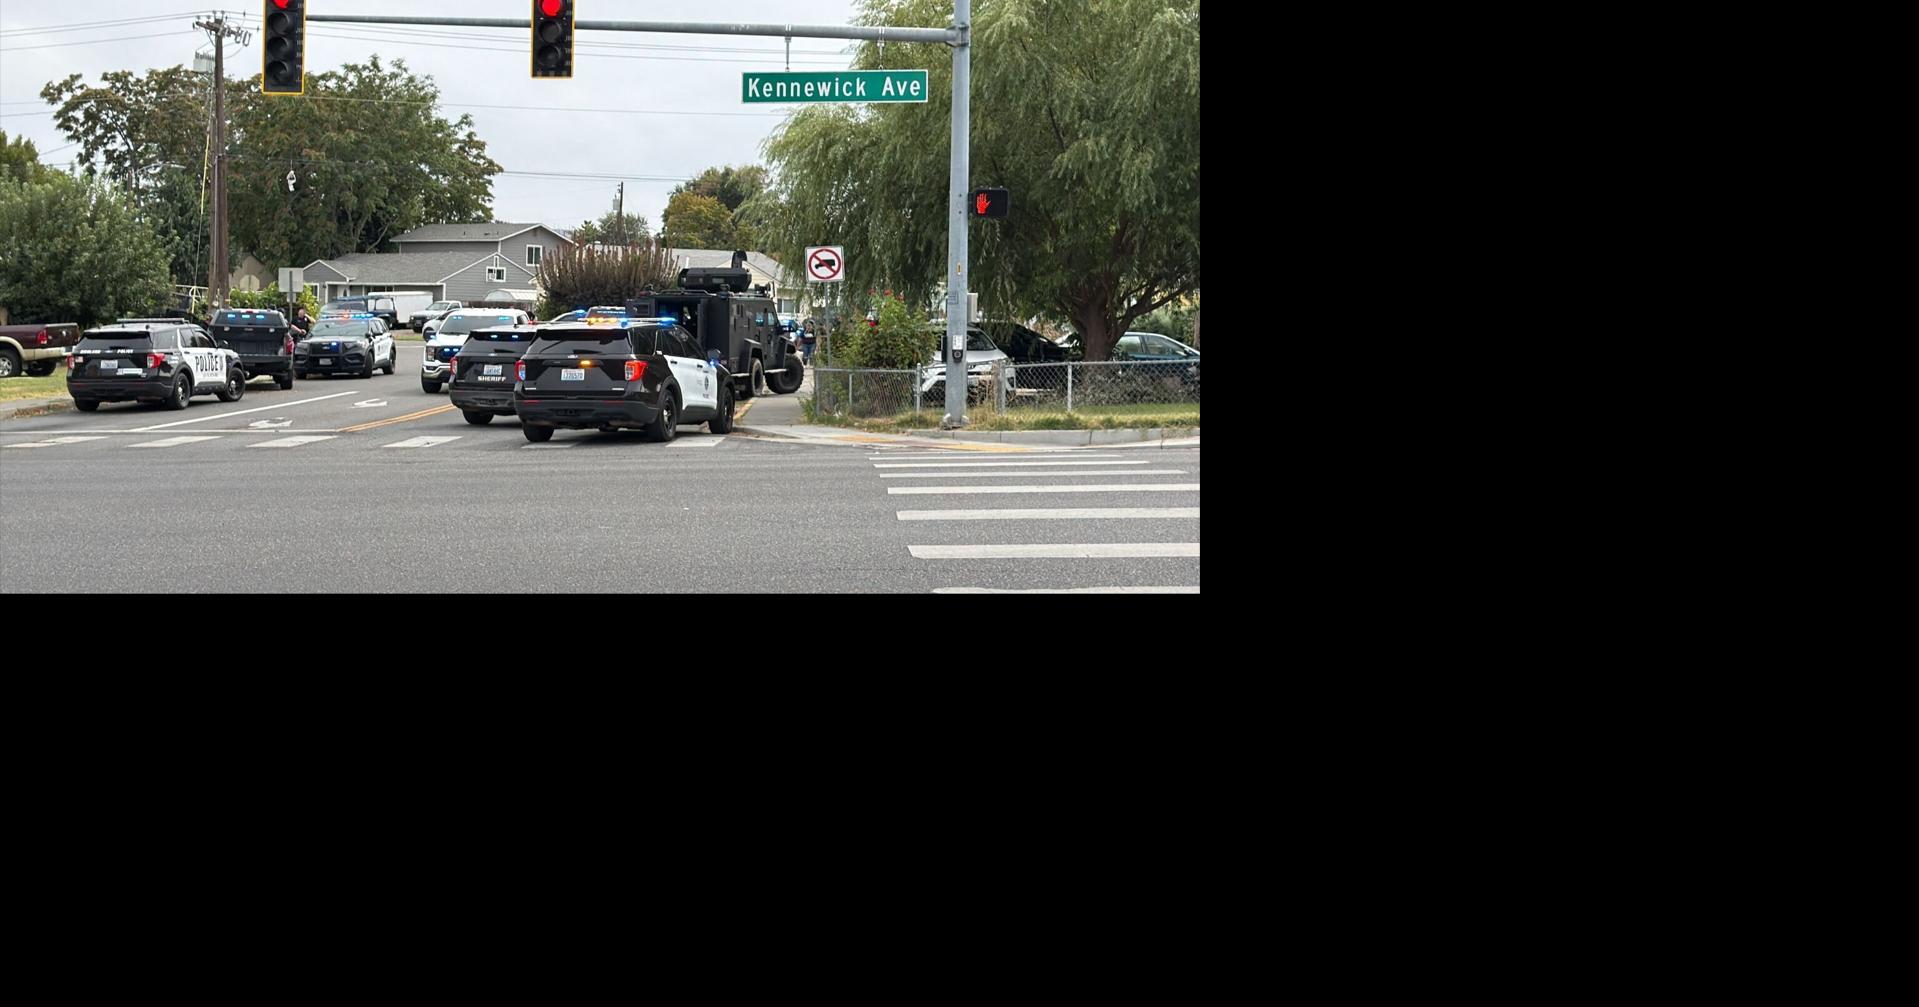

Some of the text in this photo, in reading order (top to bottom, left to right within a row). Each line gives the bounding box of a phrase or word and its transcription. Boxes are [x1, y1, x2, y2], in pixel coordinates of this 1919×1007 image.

[748, 76, 921, 98] Kennewick Ave
[195, 355, 218, 372] POLICE
